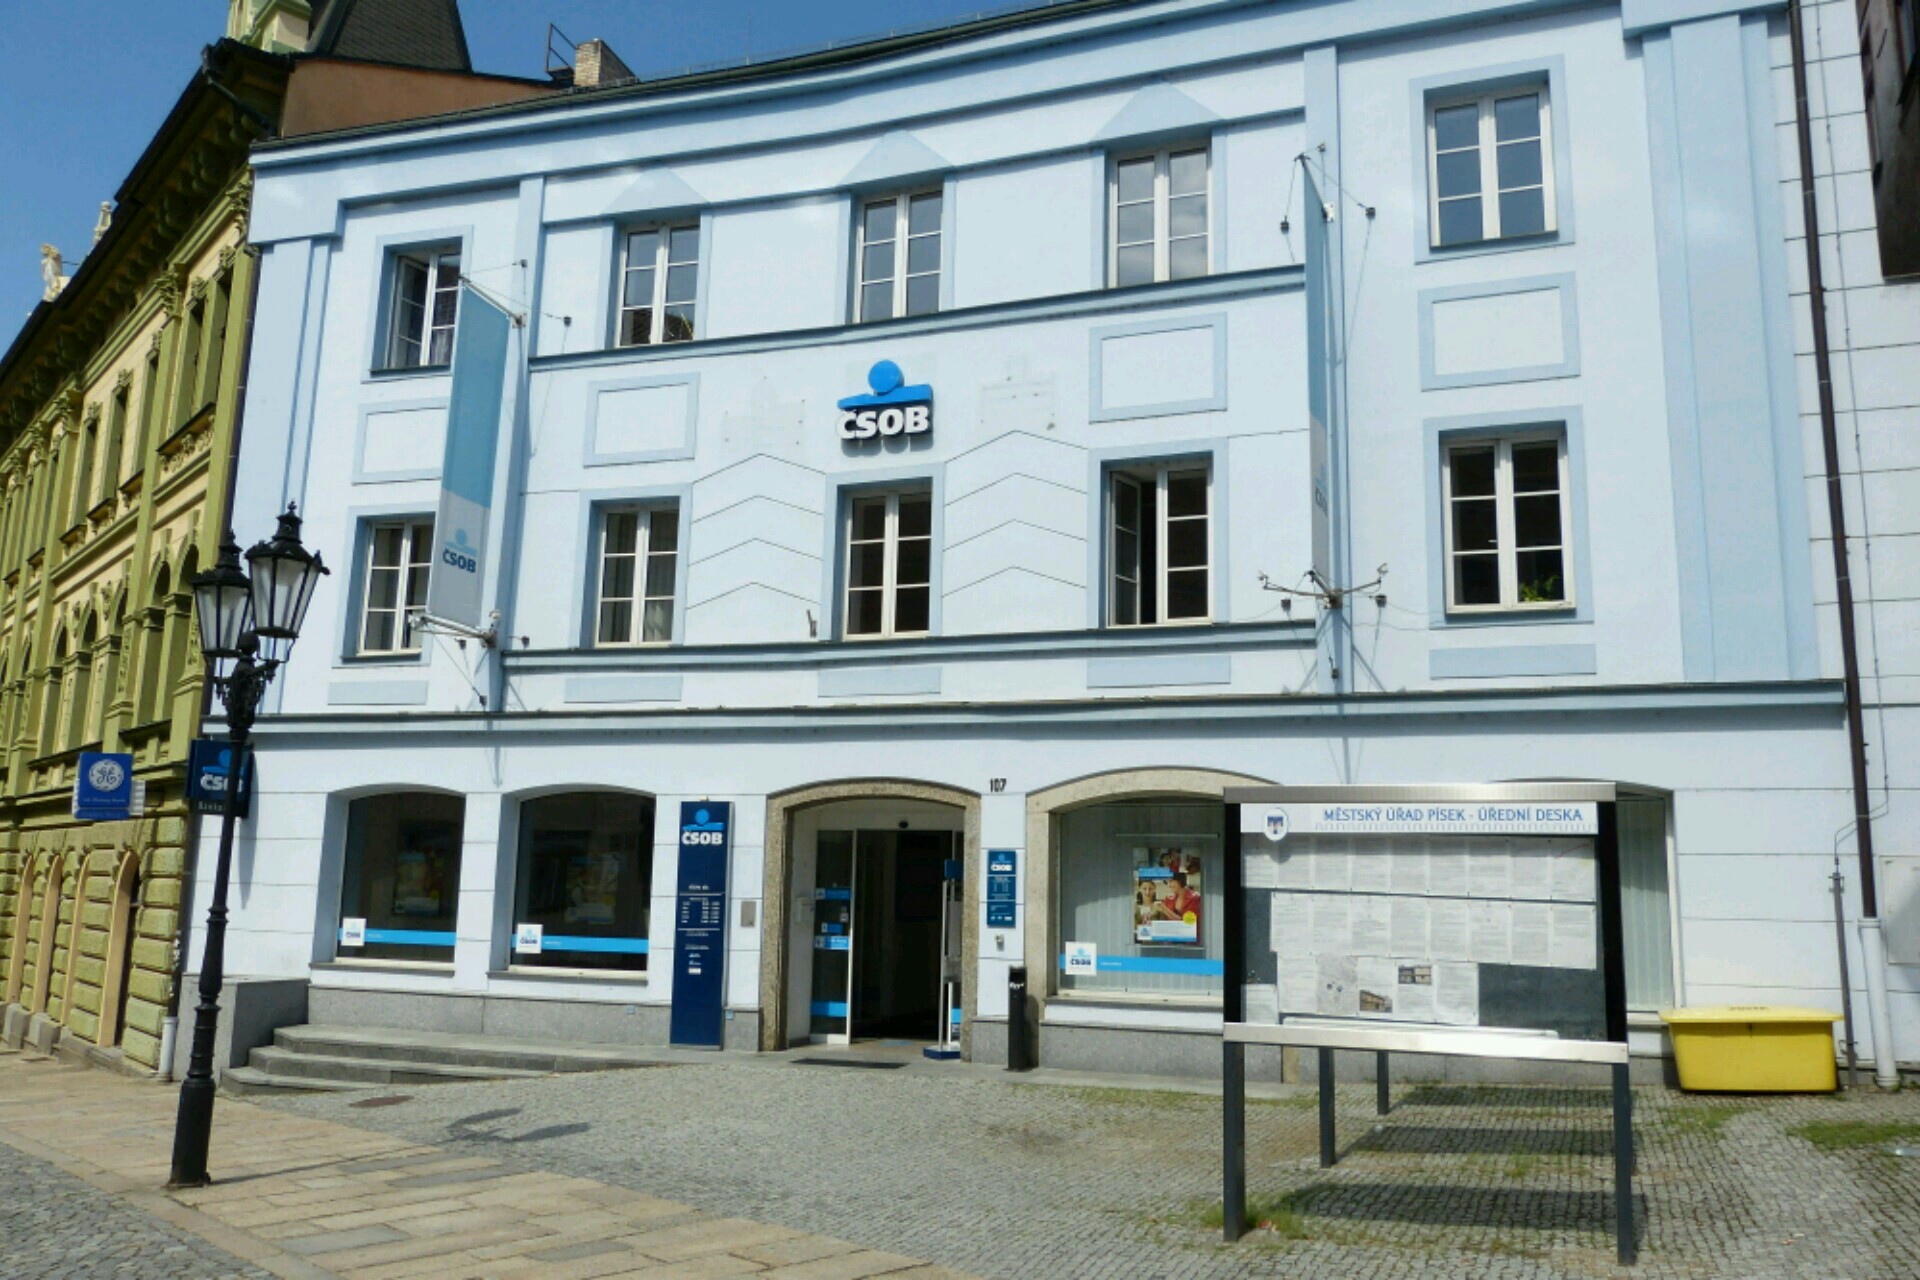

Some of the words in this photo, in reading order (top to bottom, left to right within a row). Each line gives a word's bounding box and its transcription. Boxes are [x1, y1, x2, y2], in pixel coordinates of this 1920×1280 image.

[837, 406, 929, 439] ČSOB
[1324, 806, 1381, 821] MĚSTSKÝ
[1386, 806, 1423, 821] ÚŘAD
[1428, 806, 1465, 821] PÍSEK
[1478, 806, 1530, 821] ÚŘEDNÍ
[1536, 809, 1583, 821] DESKA
